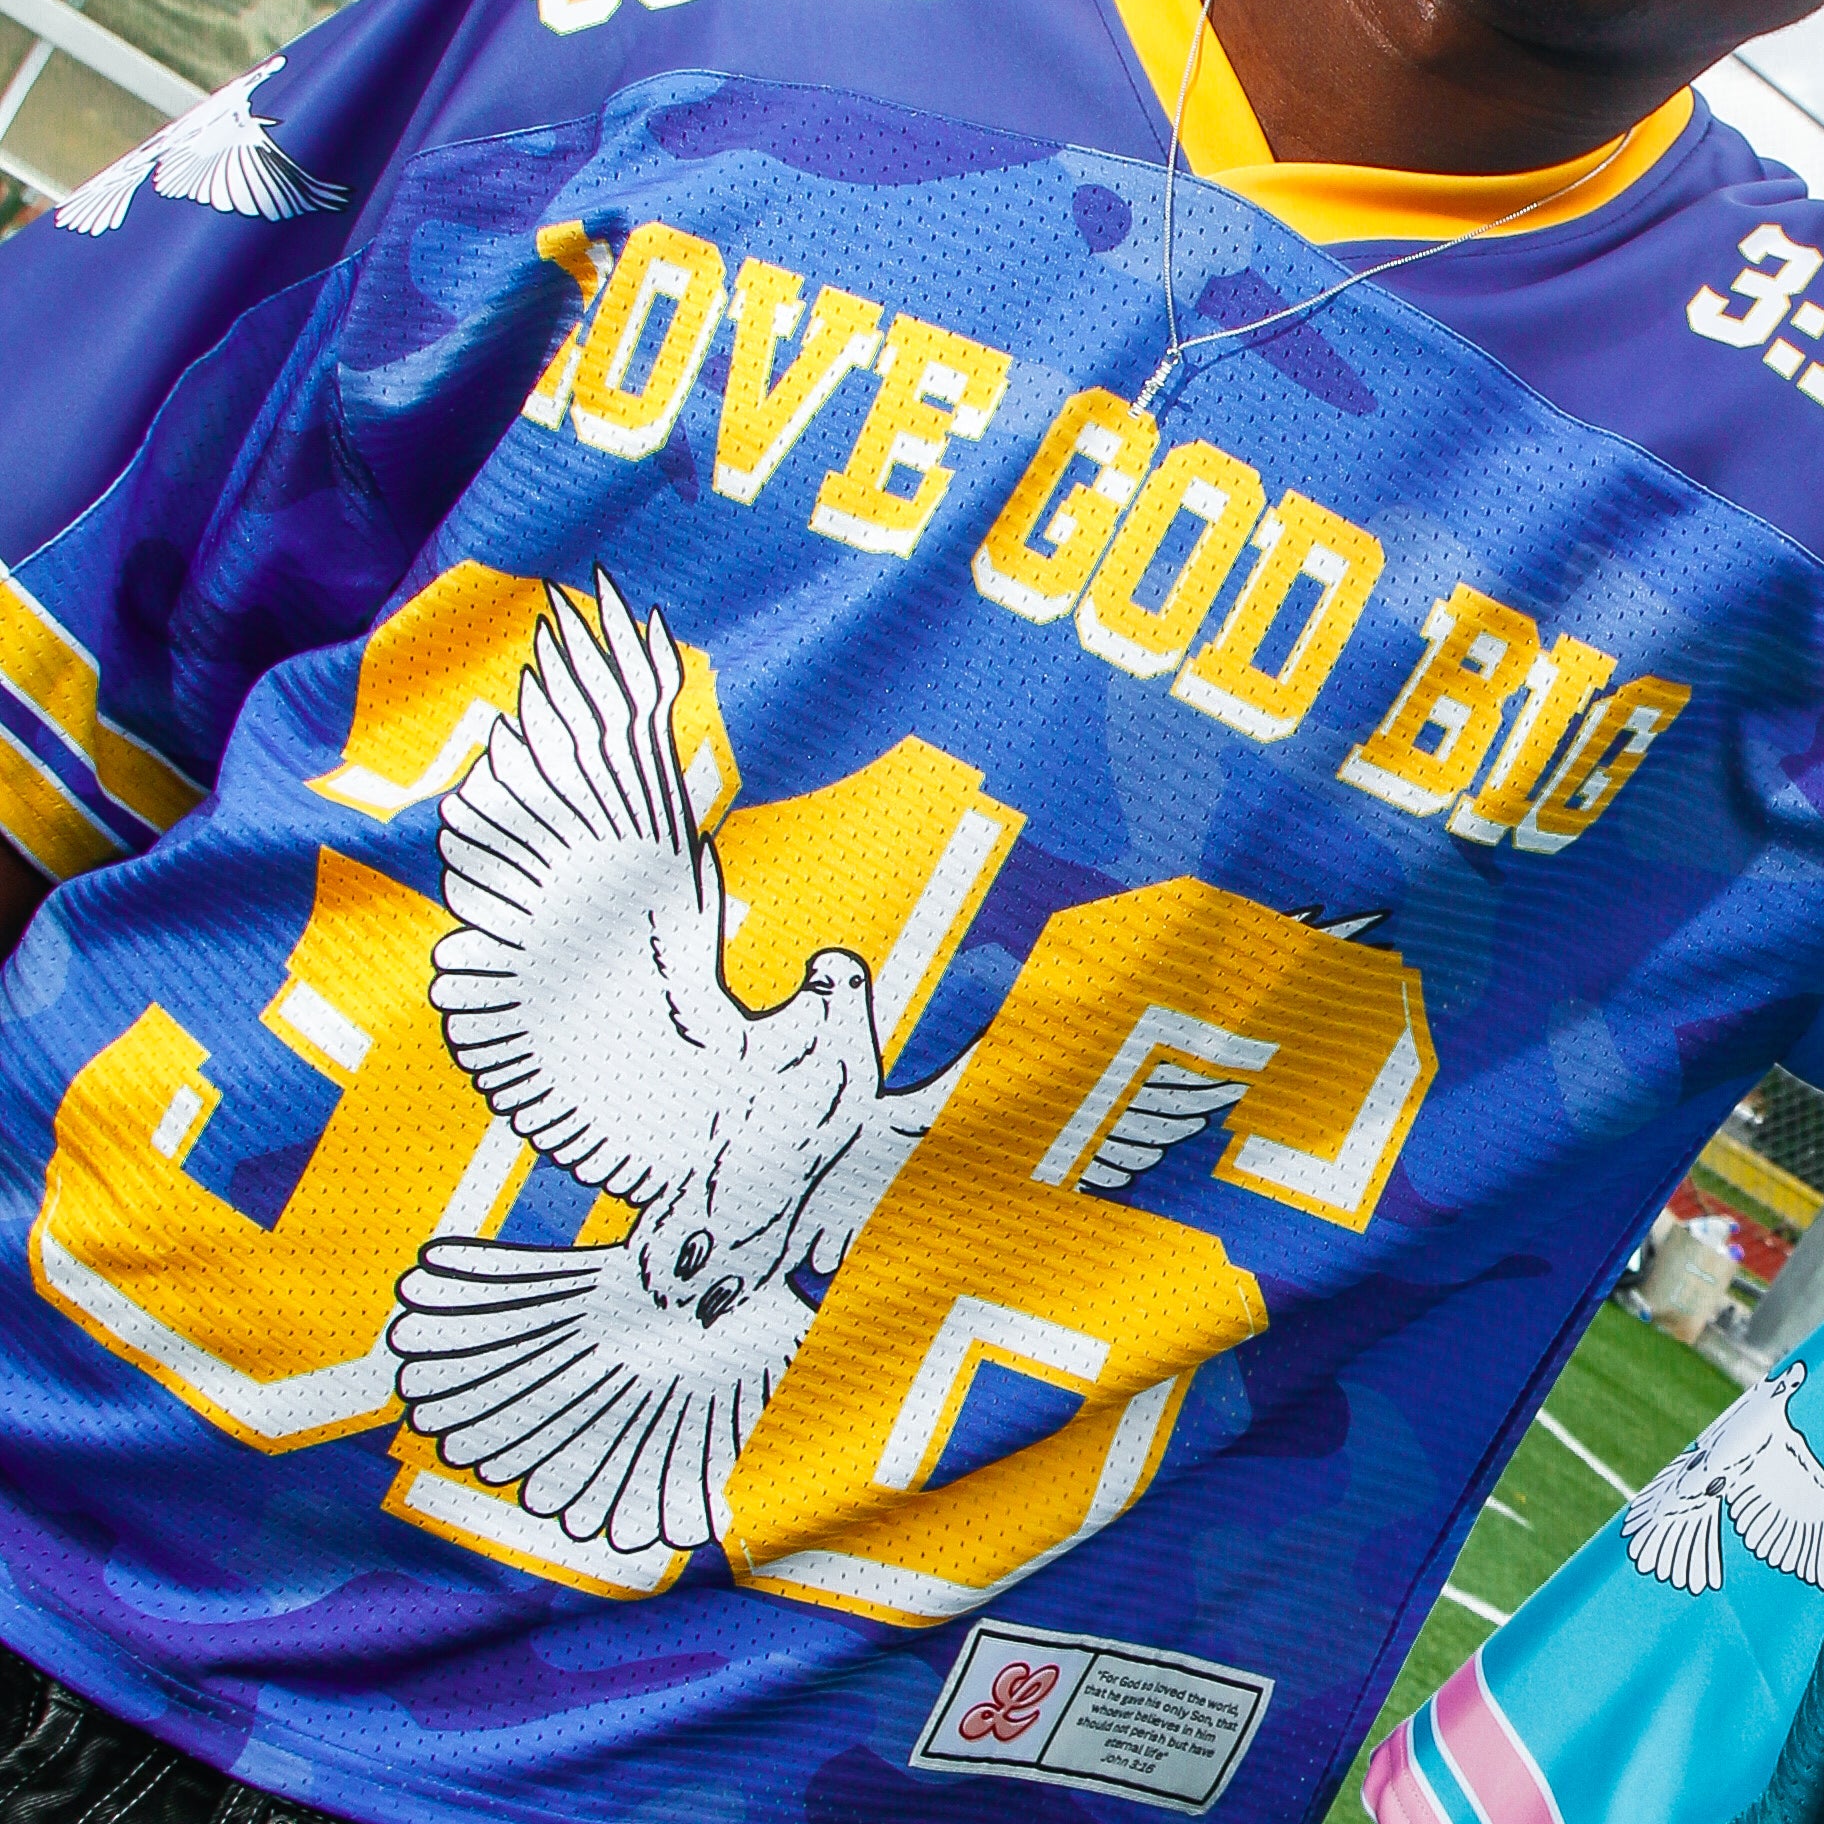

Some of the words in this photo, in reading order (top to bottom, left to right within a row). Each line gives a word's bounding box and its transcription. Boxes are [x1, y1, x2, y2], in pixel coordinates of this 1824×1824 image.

[972, 386, 1387, 744] GOD
[1336, 583, 1693, 856] BIG
[1084, 1684, 1108, 1699] that
[1108, 1689, 1121, 1701] he
[1120, 1694, 1146, 1706] gave
[1146, 1696, 1162, 1709] his
[1162, 1703, 1191, 1720] only
[1190, 1710, 1214, 1727] Son,
[1215, 1718, 1238, 1732] that
[1120, 1676, 1140, 1689] God
[1140, 1682, 1153, 1691] so
[1153, 1682, 1187, 1700] loved
[1187, 1693, 1207, 1706] the
[1207, 1700, 1239, 1717] world,
[1076, 1716, 1113, 1732] should
[1112, 1723, 1130, 1734] not
[1129, 1725, 1167, 1744] perish
[1167, 1736, 1190, 1751] but
[1188, 1743, 1215, 1758] have
[1091, 1704, 1134, 1719] whoever
[1134, 1710, 1180, 1733] believes
[1182, 1724, 1194, 1735] in
[1195, 1728, 1217, 1742] him
[1100, 1754, 1129, 1768] John
[1129, 1760, 1156, 1774] 3:16
[1104, 1738, 1143, 1755] eternal
